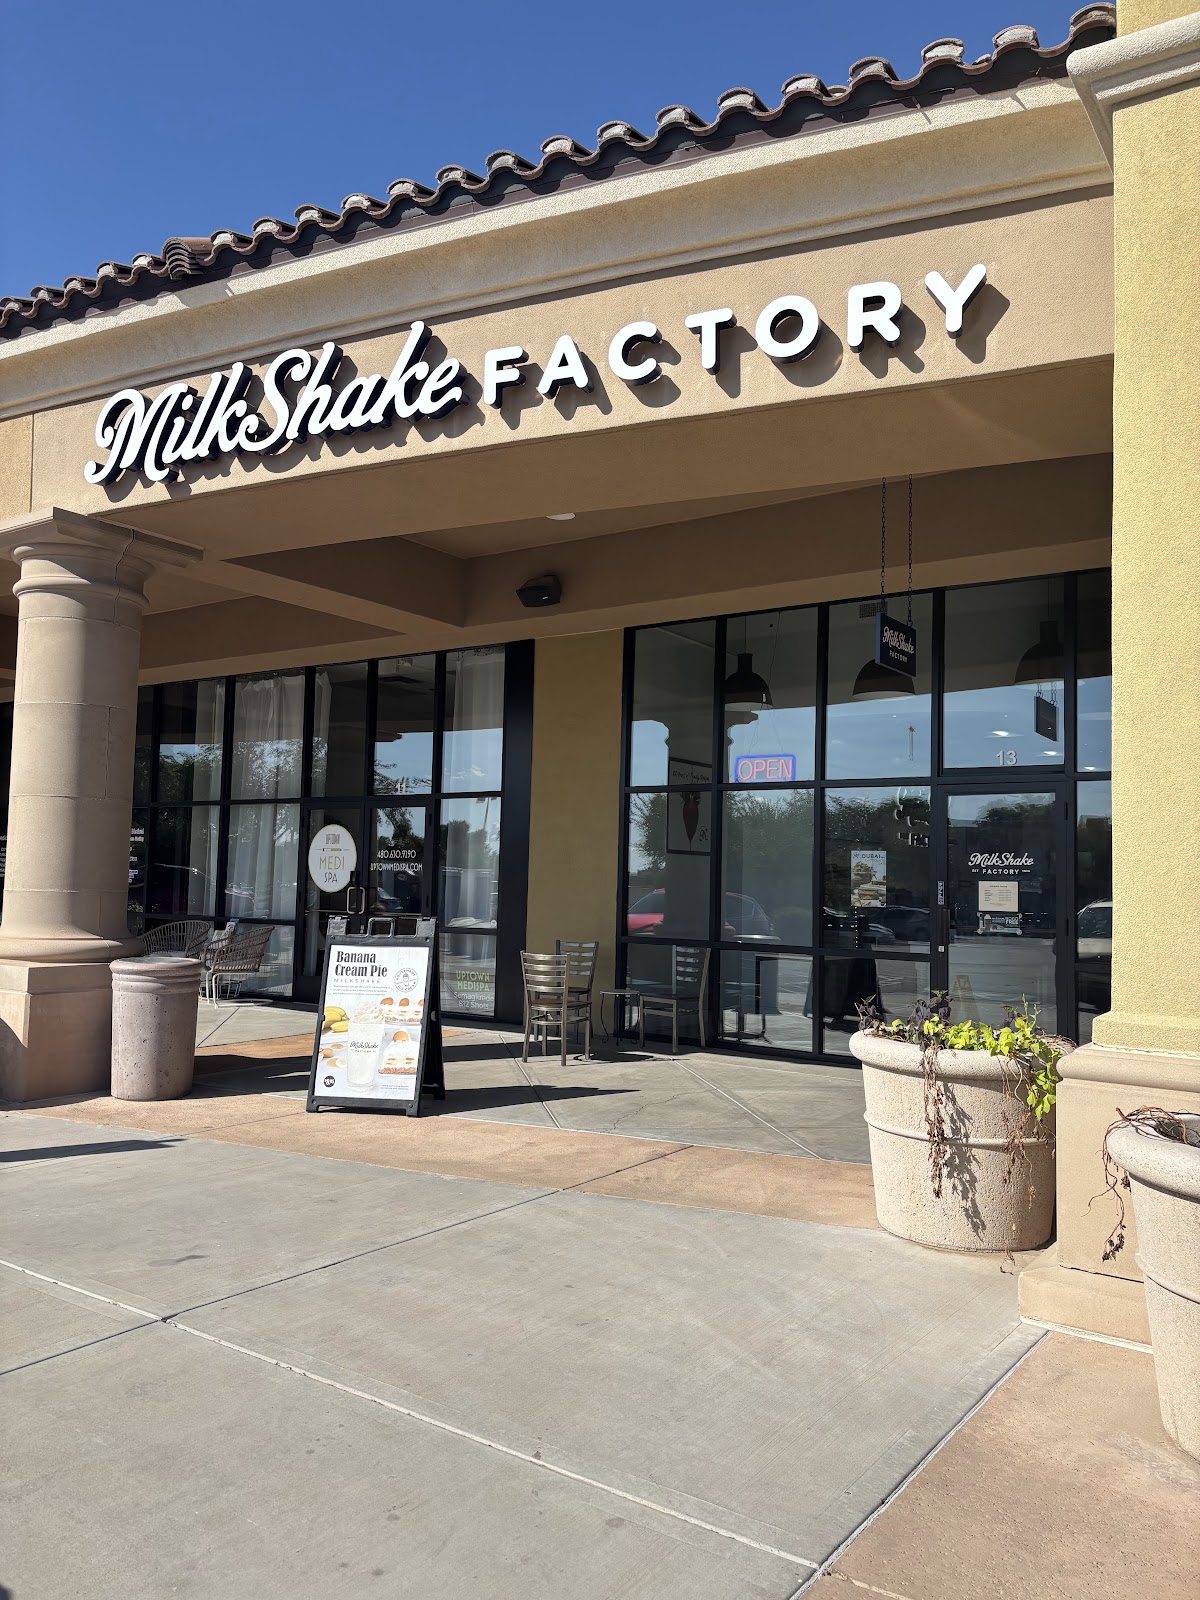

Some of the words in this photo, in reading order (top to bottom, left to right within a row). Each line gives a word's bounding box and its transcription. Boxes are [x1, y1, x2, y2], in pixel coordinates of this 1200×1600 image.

[84, 320, 464, 484] MilkShake
[483, 263, 987, 407] FACTORY
[996, 750, 1018, 766] 13
[738, 758, 793, 780] OPEN
[319, 855, 345, 870] MEDI
[968, 852, 1035, 868] MilkShake
[324, 871, 338, 883] SPA
[336, 950, 377, 964] Banana
[334, 963, 368, 977] Cream
[370, 964, 388, 977] Pie
[456, 970, 490, 982] UPTOWN
[457, 981, 490, 992] MEDISPA
[470, 1001, 489, 1010] Shots
